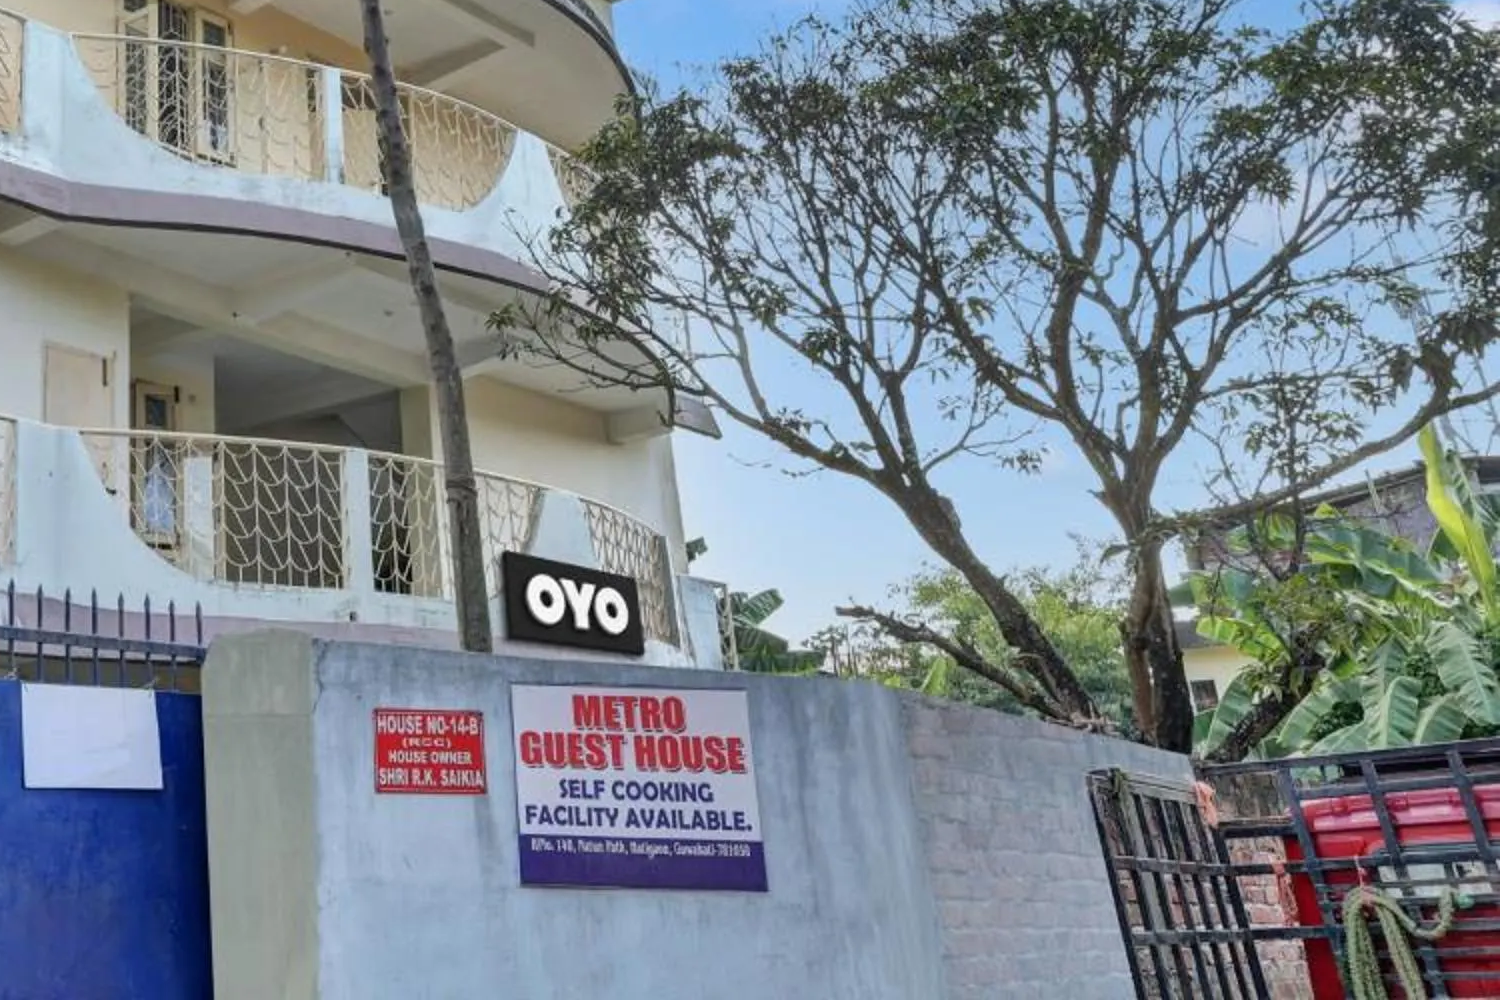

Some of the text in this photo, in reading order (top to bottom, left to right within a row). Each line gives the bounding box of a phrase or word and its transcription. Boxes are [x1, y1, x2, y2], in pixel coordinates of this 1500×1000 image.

[526, 573, 629, 635] OYO
[377, 715, 423, 736] HOUSE
[572, 694, 687, 733] METRO
[387, 750, 472, 765] HOUSE OWNER
[519, 730, 747, 775] GUEST HOUSE
[379, 767, 409, 786] SHRI
[559, 778, 715, 803] SELF COOKING
[525, 805, 753, 832] FACILITY AVAILABLE.
